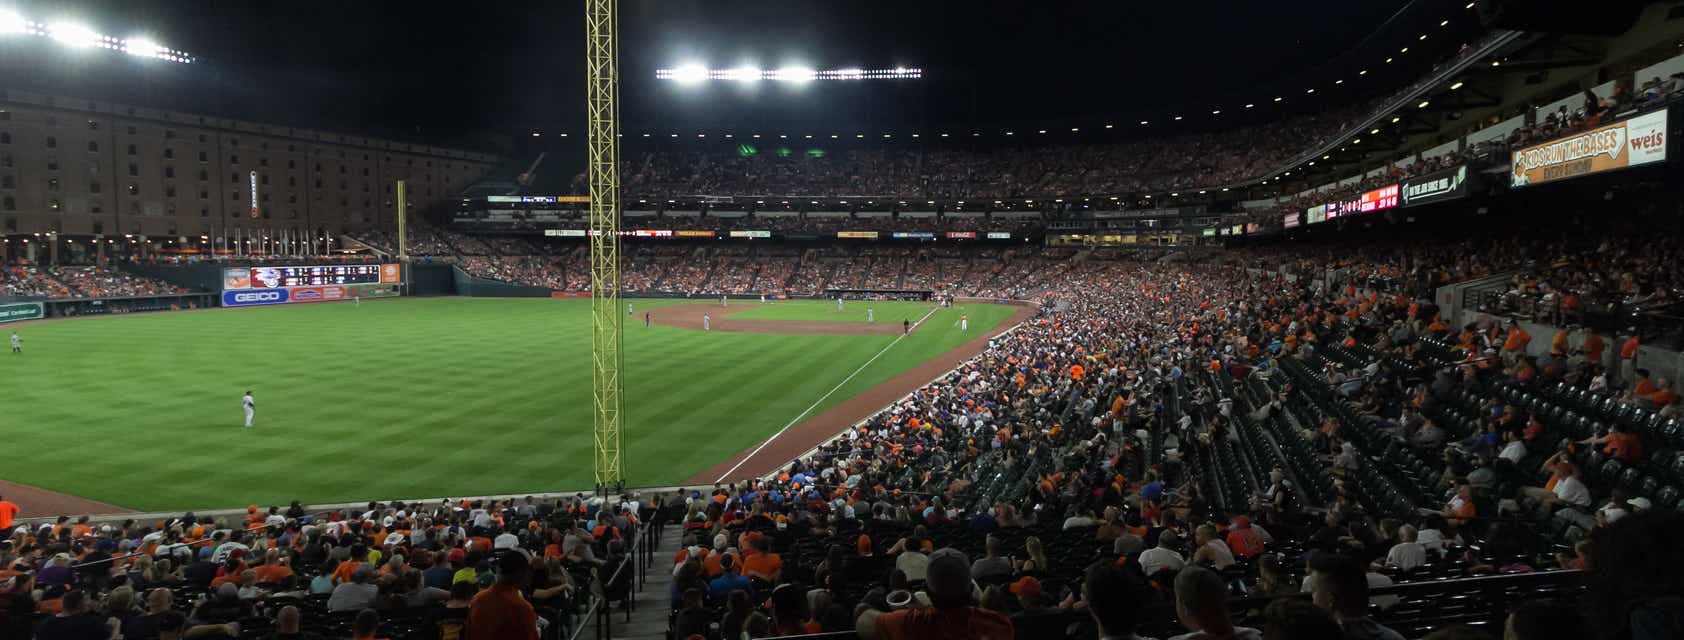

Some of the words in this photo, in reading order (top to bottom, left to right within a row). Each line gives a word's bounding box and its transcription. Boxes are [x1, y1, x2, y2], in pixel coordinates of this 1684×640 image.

[1525, 148, 1544, 169] KIDS
[1545, 143, 1562, 164] RUN
[1563, 138, 1582, 160] THE
[1583, 130, 1617, 155] BASES
[1631, 129, 1663, 151] weis
[235, 291, 280, 303] GEICO
